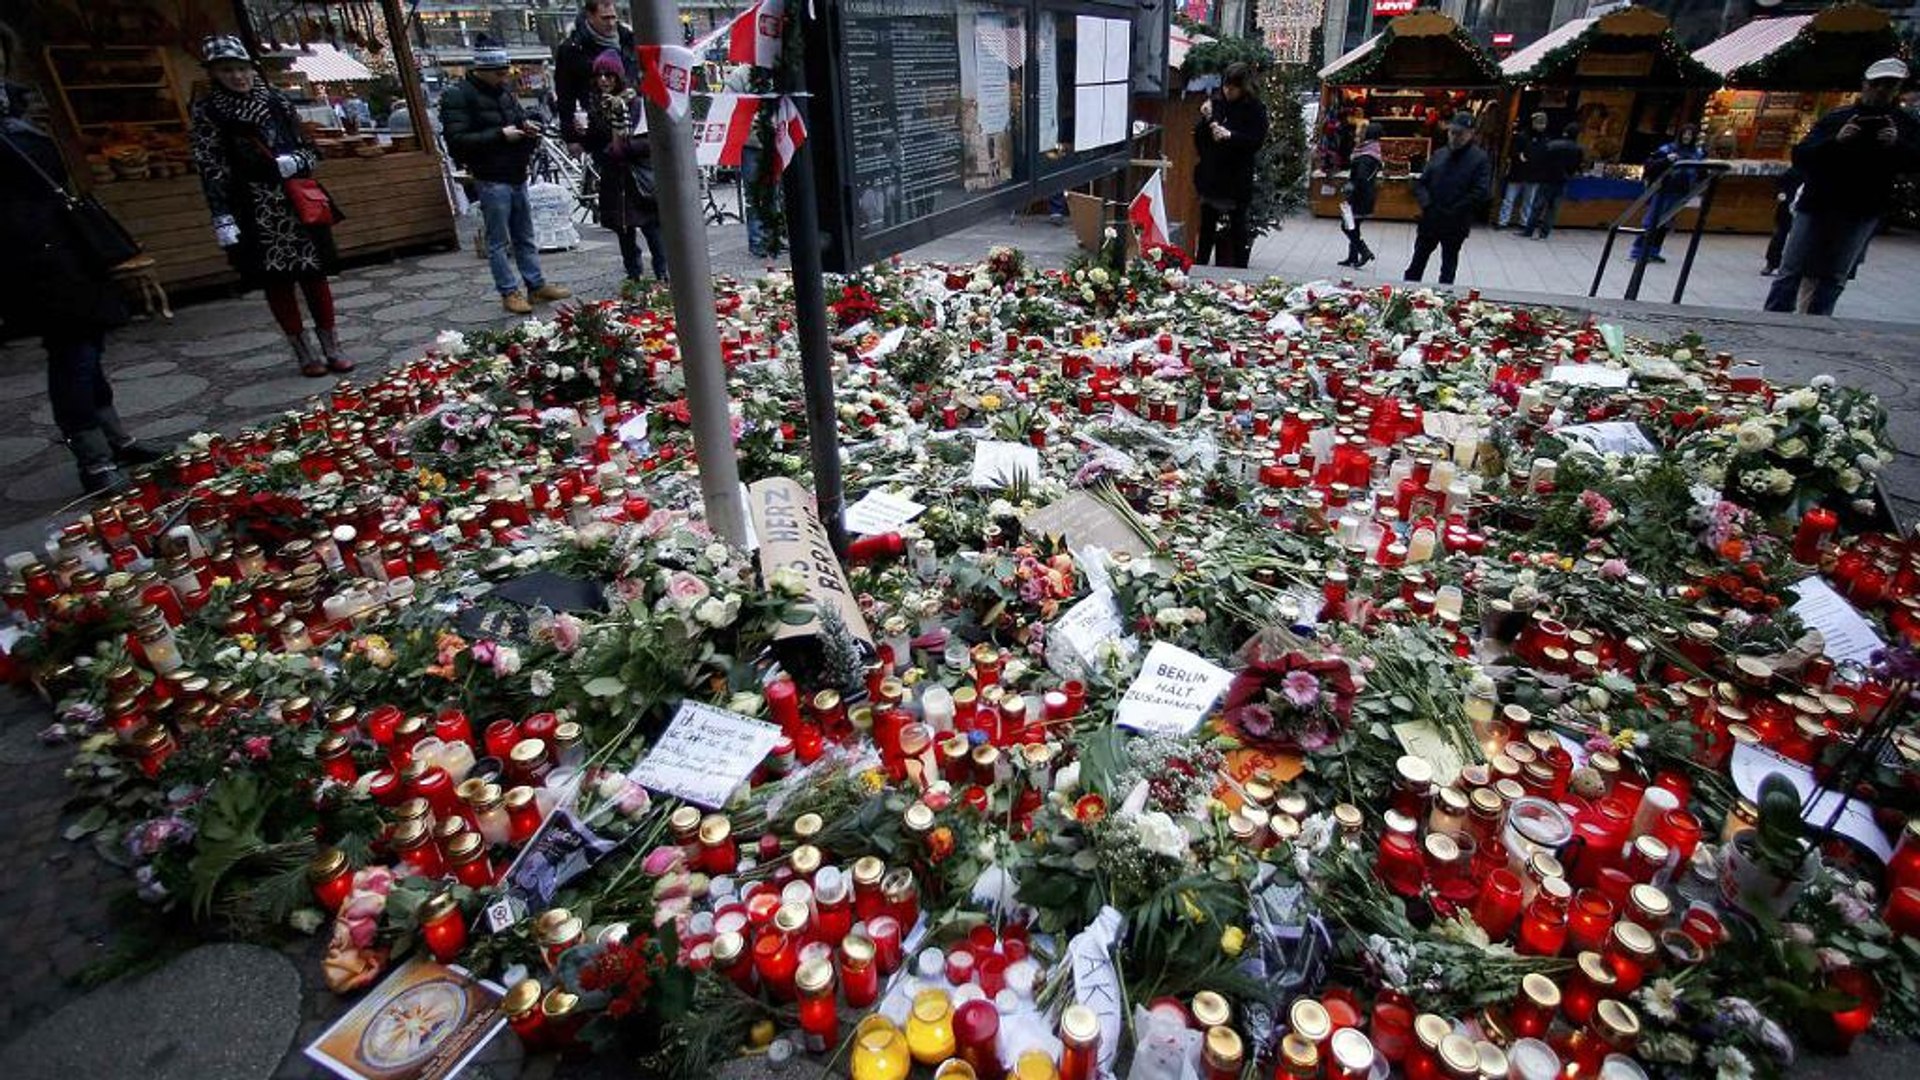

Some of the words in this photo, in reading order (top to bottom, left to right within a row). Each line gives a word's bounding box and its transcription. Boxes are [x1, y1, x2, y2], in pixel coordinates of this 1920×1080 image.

[764, 487, 799, 542] HERZ
[1156, 663, 1209, 684] BERLIN
[1126, 689, 1205, 712] ZUSAMMEN
